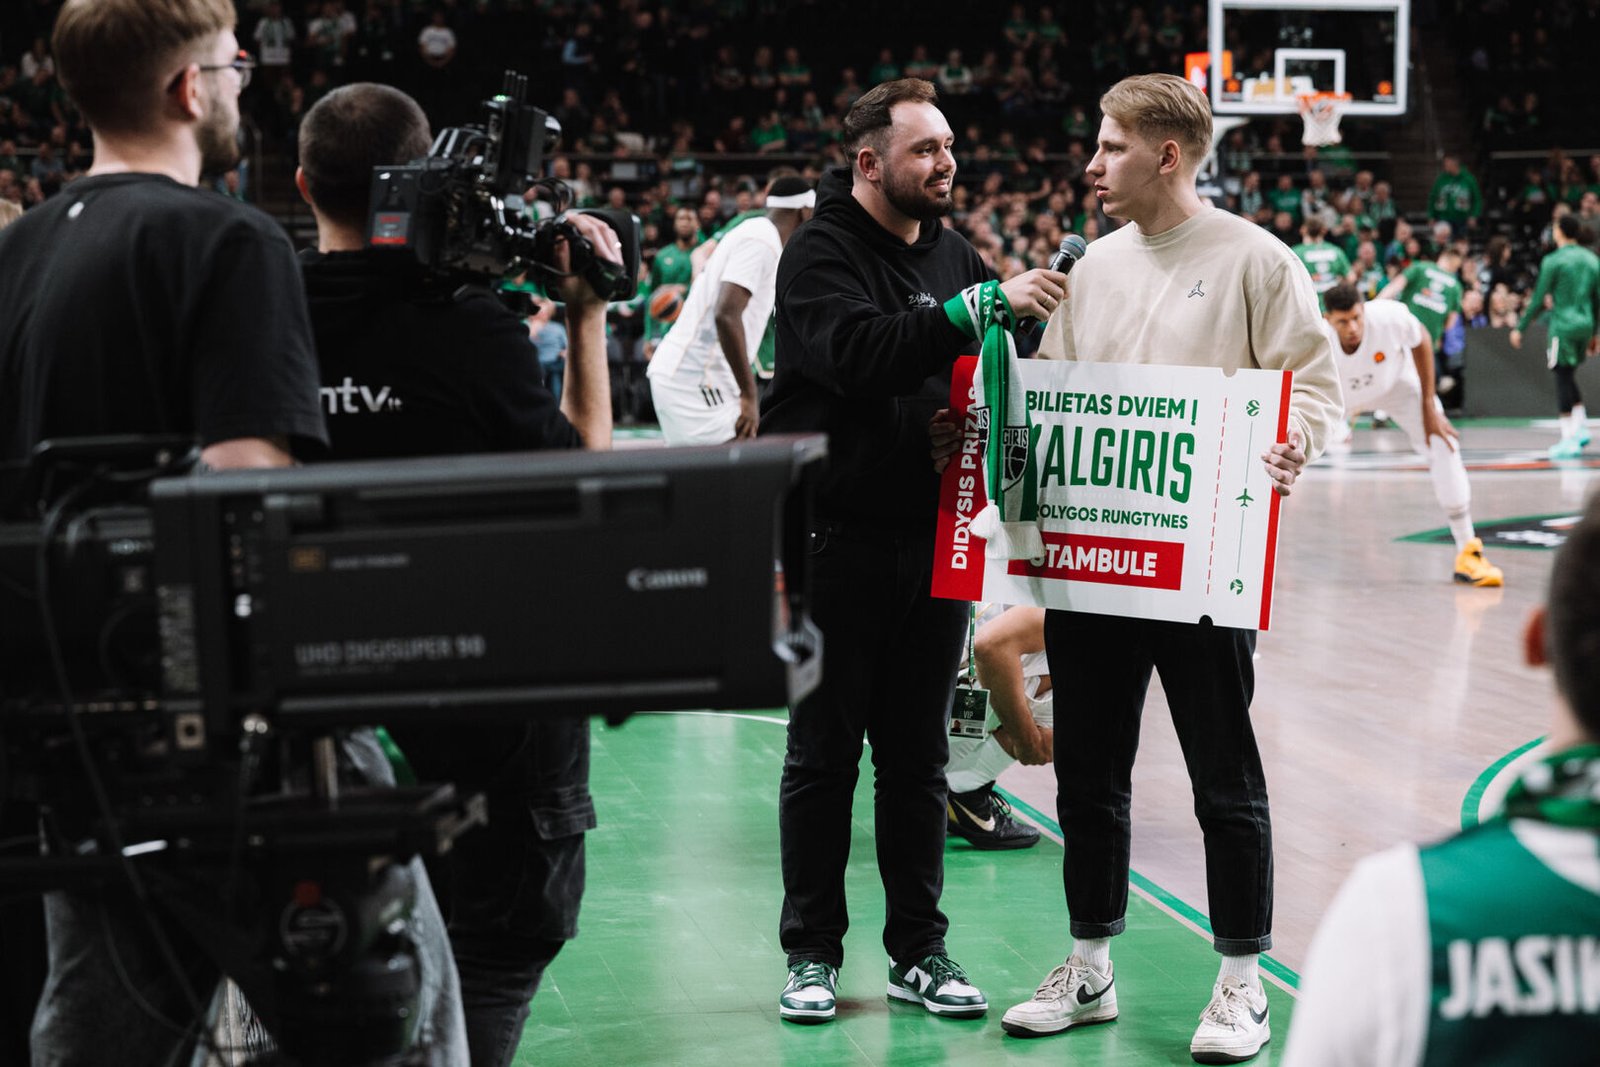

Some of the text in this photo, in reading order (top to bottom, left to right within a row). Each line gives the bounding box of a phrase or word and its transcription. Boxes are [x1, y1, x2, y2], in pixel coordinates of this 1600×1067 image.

[1026, 390, 1113, 416] BILIETAS
[1117, 395, 1186, 419] DVIEM
[951, 474, 976, 570] DIDYSIS
[1036, 503, 1189, 530] OLYGOS RUNGTYNES
